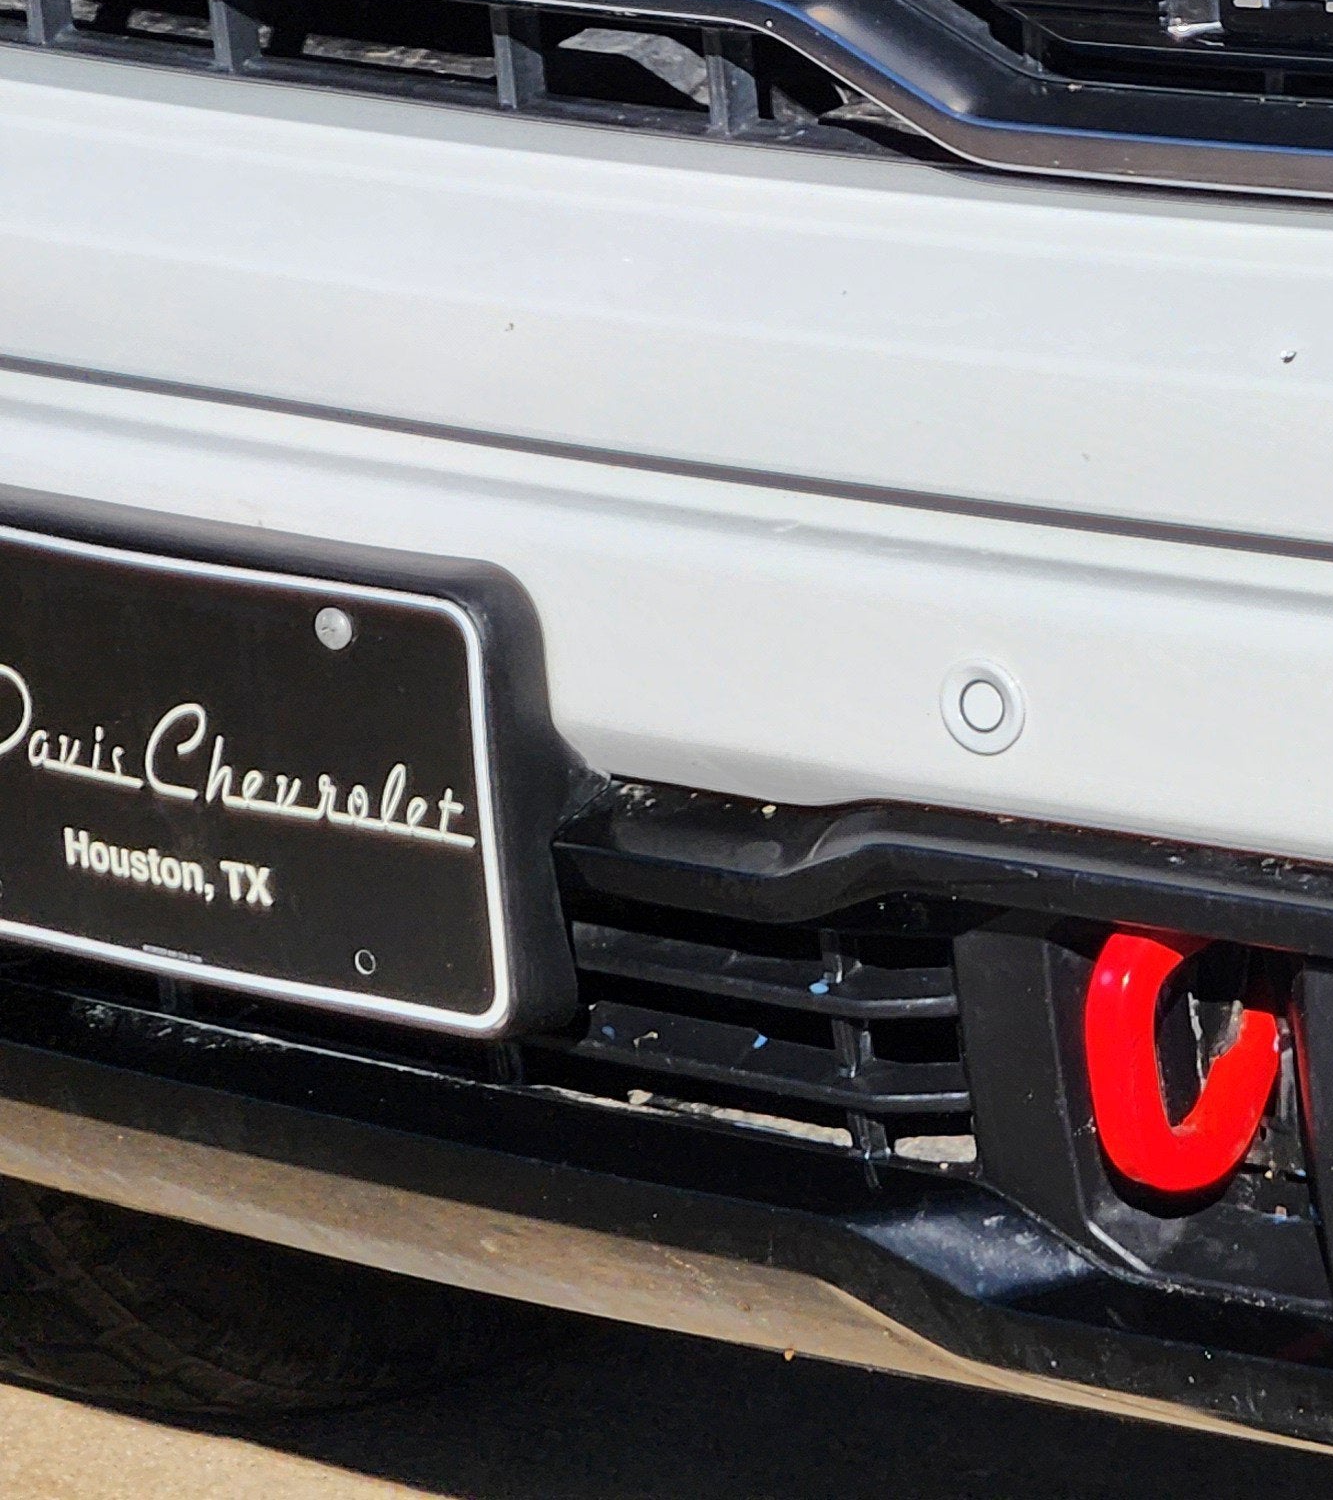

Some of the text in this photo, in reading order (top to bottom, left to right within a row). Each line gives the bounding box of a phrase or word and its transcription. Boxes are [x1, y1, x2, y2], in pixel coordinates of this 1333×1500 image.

[145, 703, 476, 848] Chevrolet
[63, 826, 274, 907] Houston, TX
